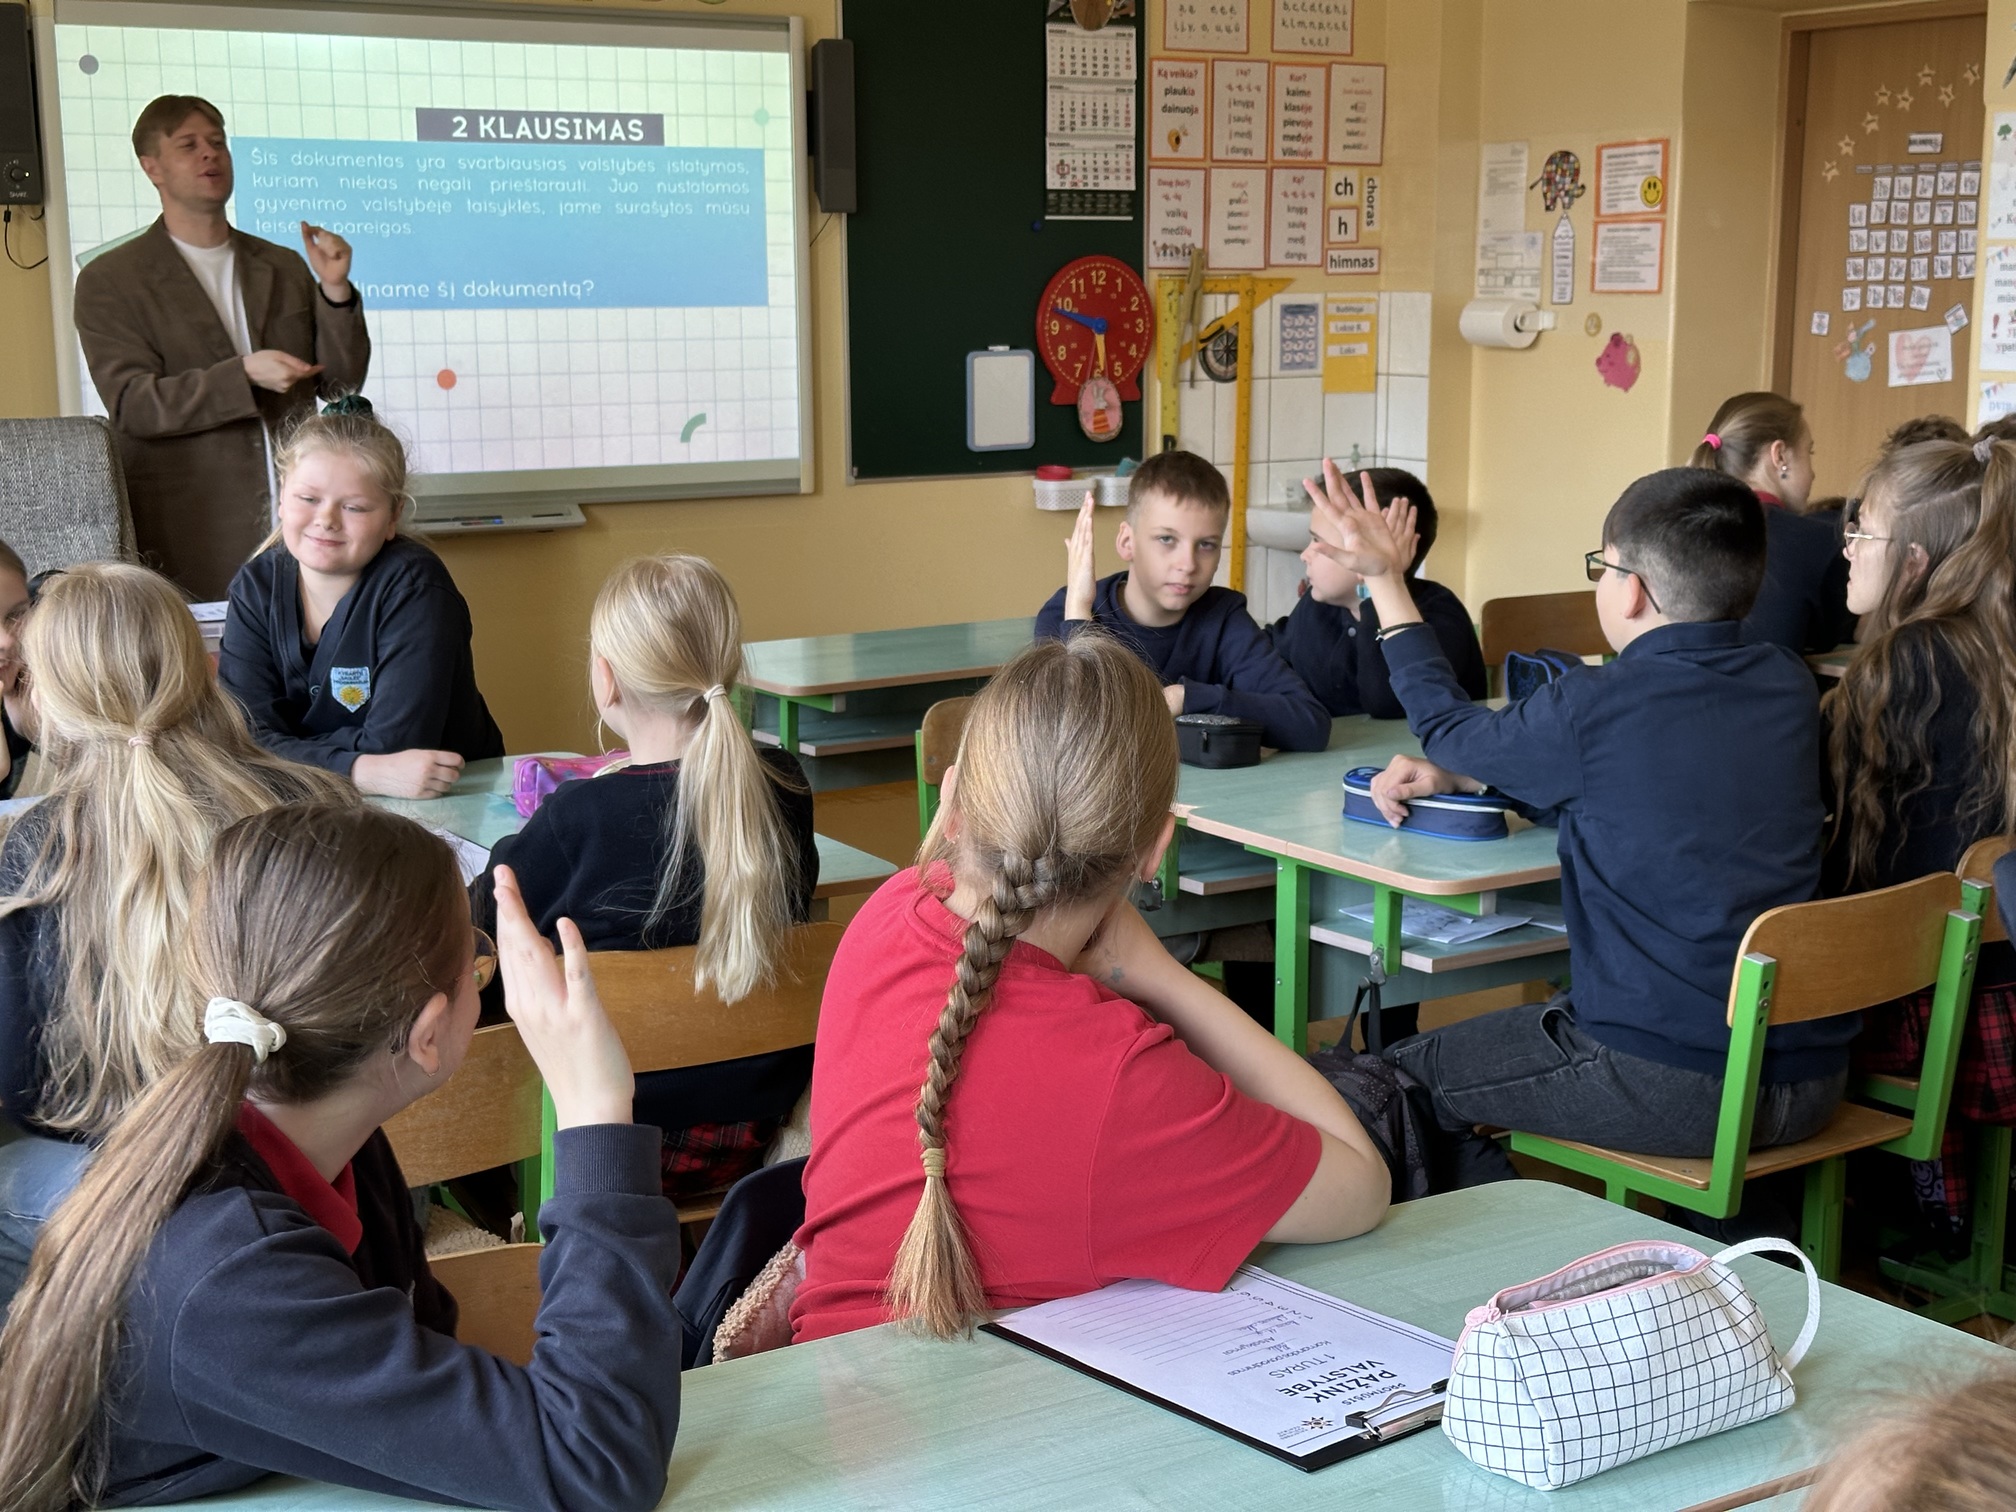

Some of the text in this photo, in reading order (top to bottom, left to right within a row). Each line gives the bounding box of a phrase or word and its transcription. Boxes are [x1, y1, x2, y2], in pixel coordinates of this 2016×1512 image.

[1164, 85, 1195, 97] plaukia
[1286, 87, 1311, 97] kaime
[1161, 104, 1199, 116] dainuoja
[1284, 102, 1313, 114] klasėje
[452, 116, 645, 141] 2 KLAUSIMAS
[1283, 119, 1313, 129] pievoje
[1282, 133, 1313, 144] medyje
[1282, 148, 1313, 159] Vilniuje
[251, 147, 749, 176] Šis dokumentas yra svarbiausias valstybės įstatymas,
[252, 172, 318, 189] kuriam
[340, 175, 398, 190] niekas
[418, 176, 471, 194] negali
[608, 178, 639, 193] Juo
[657, 179, 750, 194] nustatomos
[1335, 177, 1354, 196] ch
[254, 197, 347, 214] gyvenimo
[362, 197, 452, 215] valstybėje
[559, 201, 602, 216] jame
[615, 201, 693, 217] surašytos
[706, 201, 750, 216] mūsų
[1367, 177, 1378, 227] choras
[256, 218, 302, 234] teisė
[1338, 216, 1347, 235] h
[1329, 255, 1375, 269] himnas
[1091, 270, 1107, 285] 12
[1116, 278, 1123, 292] 1
[438, 281, 455, 300] šį
[463, 280, 595, 300] dokumentą?
[1070, 278, 1085, 293] 11
[1056, 297, 1073, 312] 10
[1131, 297, 1139, 311] 2
[1051, 320, 1060, 335] 9
[1136, 318, 1145, 333] 3
[1057, 345, 1067, 360] 8
[1129, 344, 1137, 358] 4
[1074, 363, 1083, 377] 7
[1114, 362, 1123, 377] 5
[1269, 1357, 1328, 1379] TURAS
[1276, 1360, 1385, 1397] VALSTYBĘ
[1304, 1369, 1398, 1403] PAŽINK
[1341, 1382, 1406, 1405] PROTMŪŠIS
